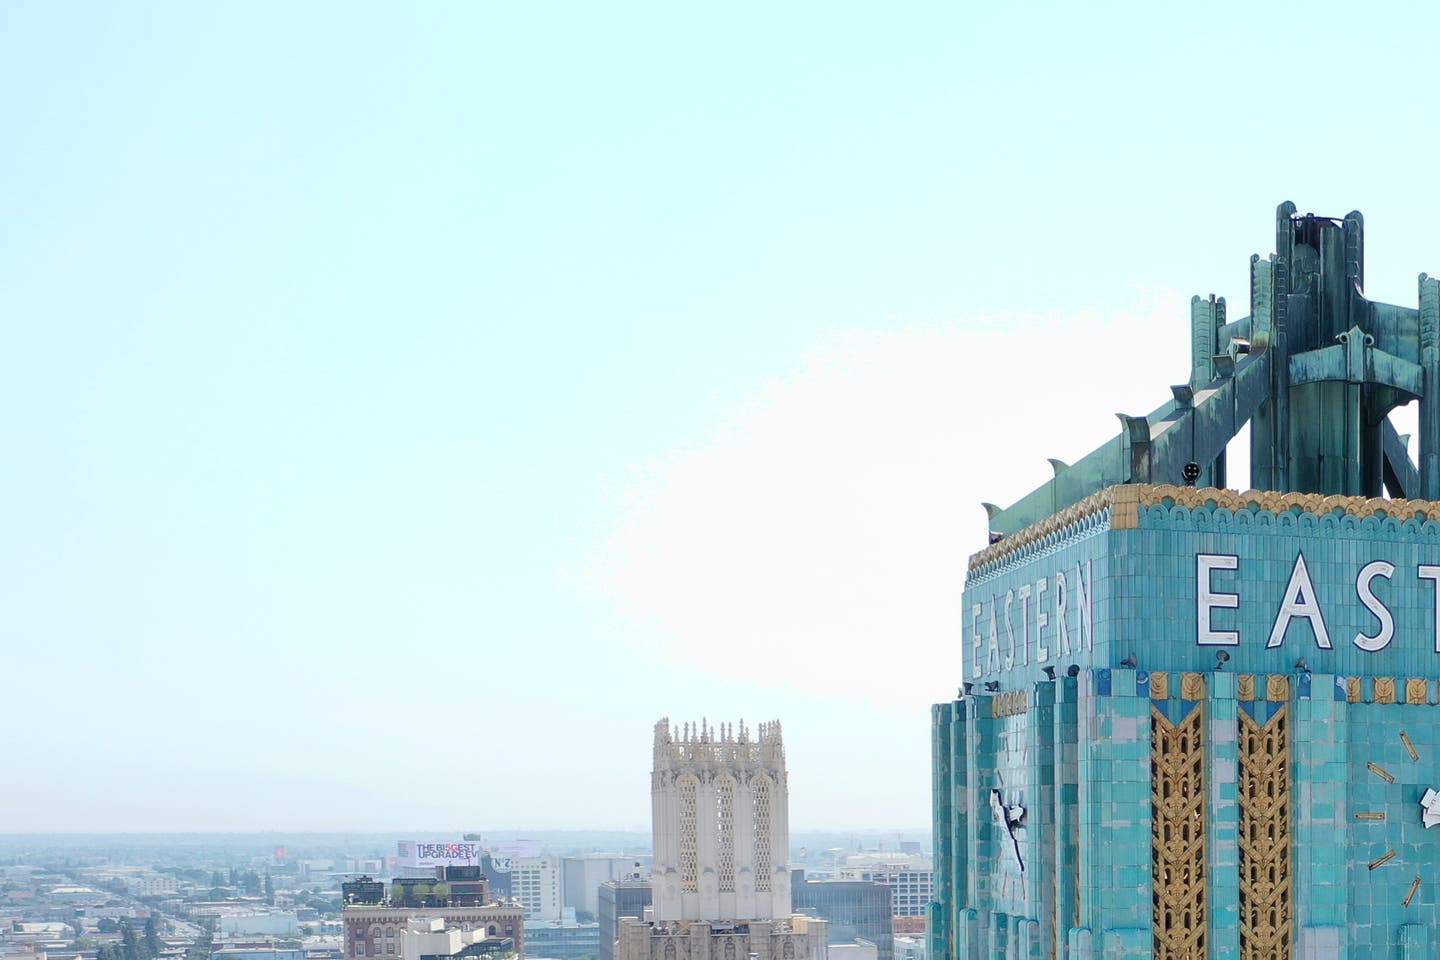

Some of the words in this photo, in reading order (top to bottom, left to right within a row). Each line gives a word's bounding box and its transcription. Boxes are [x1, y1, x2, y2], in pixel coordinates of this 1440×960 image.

[970, 558, 1094, 678] EASTERN
[417, 843, 435, 852] THE
[418, 850, 463, 859] UPGRADE
